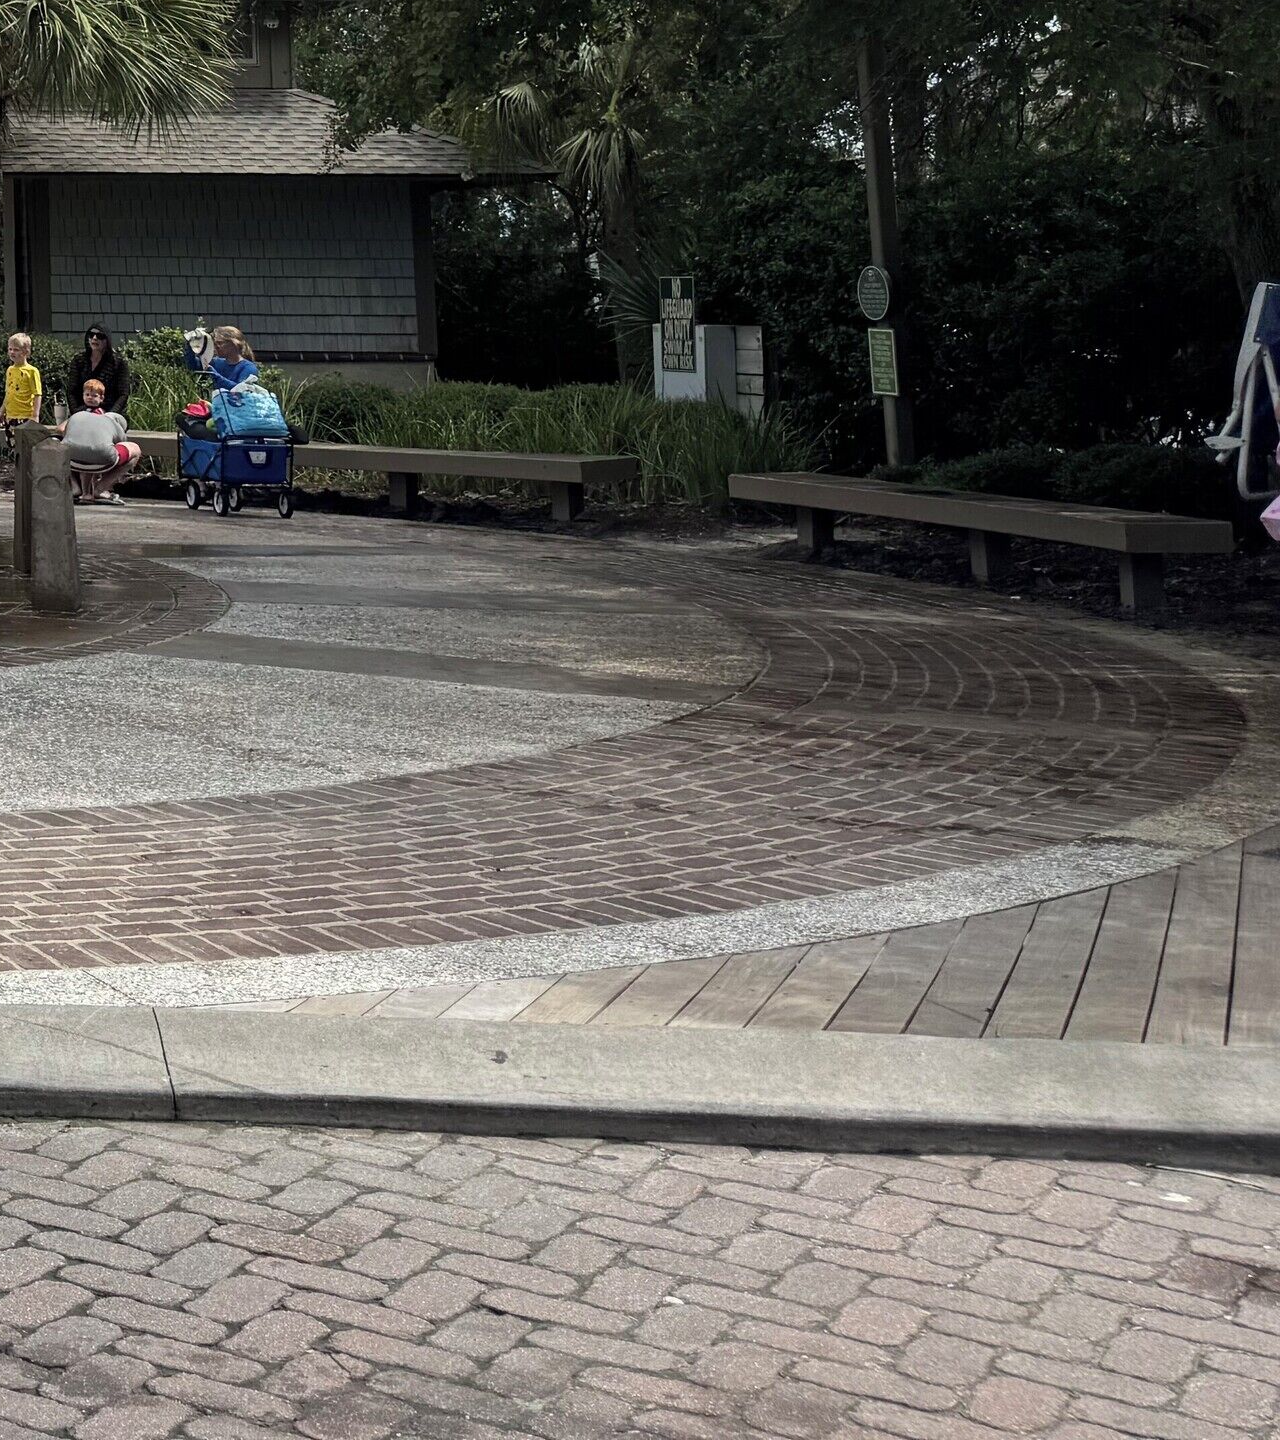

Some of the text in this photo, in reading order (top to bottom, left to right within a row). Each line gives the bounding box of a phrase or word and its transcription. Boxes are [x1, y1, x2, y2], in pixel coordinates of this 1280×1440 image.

[671, 277, 681, 299] NO
[661, 298, 693, 319] LIFEGUARD
[664, 319, 691, 339] ON DUTY
[663, 340, 692, 355] SWIM AT
[663, 354, 694, 370] OWN RISK
